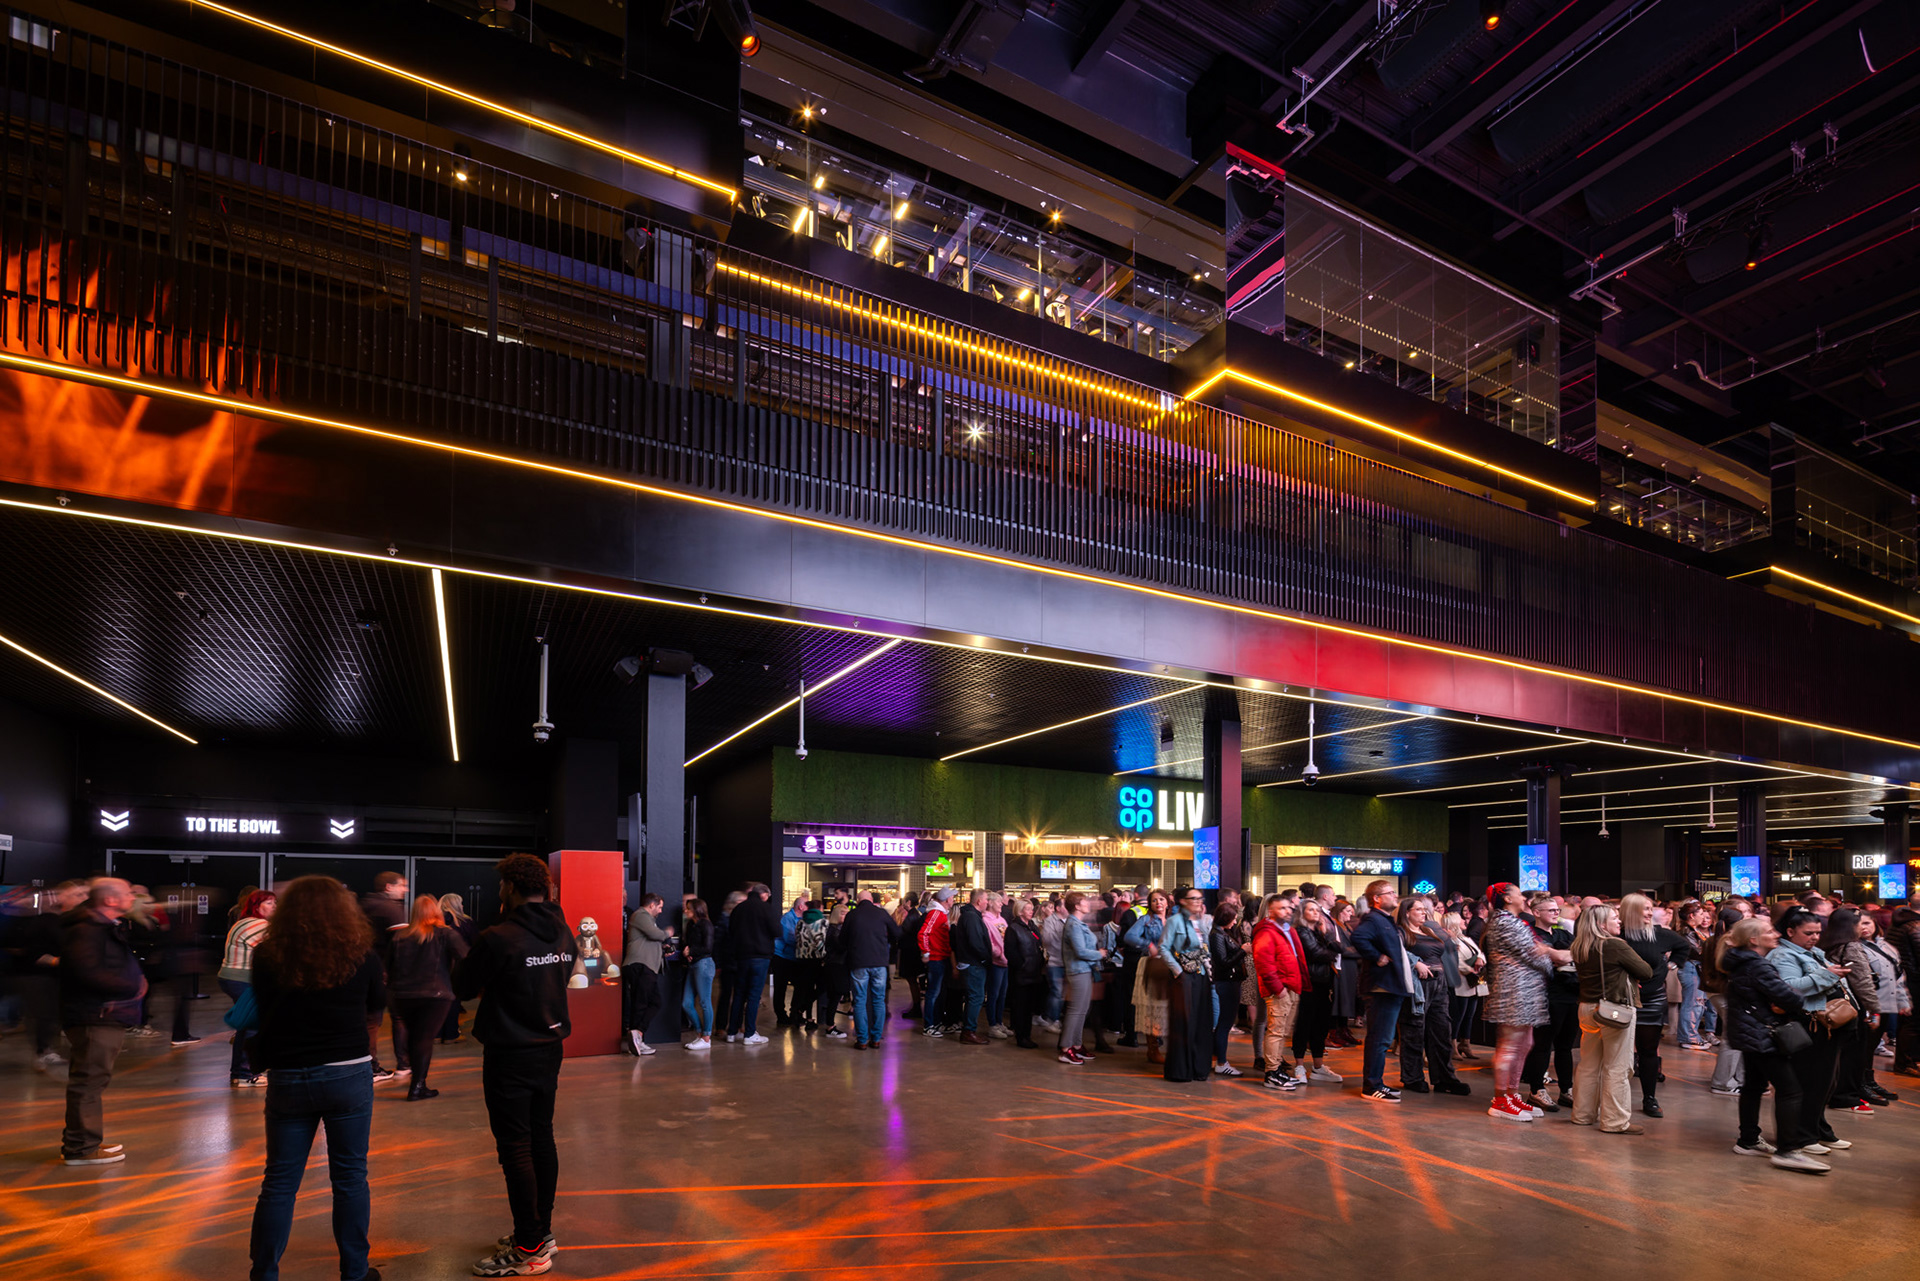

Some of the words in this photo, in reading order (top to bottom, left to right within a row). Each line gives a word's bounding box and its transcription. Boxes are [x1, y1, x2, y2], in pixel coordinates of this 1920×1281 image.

[186, 817, 206, 832] TO
[208, 818, 237, 833] THE
[239, 819, 281, 834] BOWL
[826, 840, 868, 851] SOUND
[874, 841, 913, 853] BITES
[1345, 859, 1367, 871] Co-op
[1367, 860, 1392, 871] Kitchen
[525, 953, 560, 967] Studio
